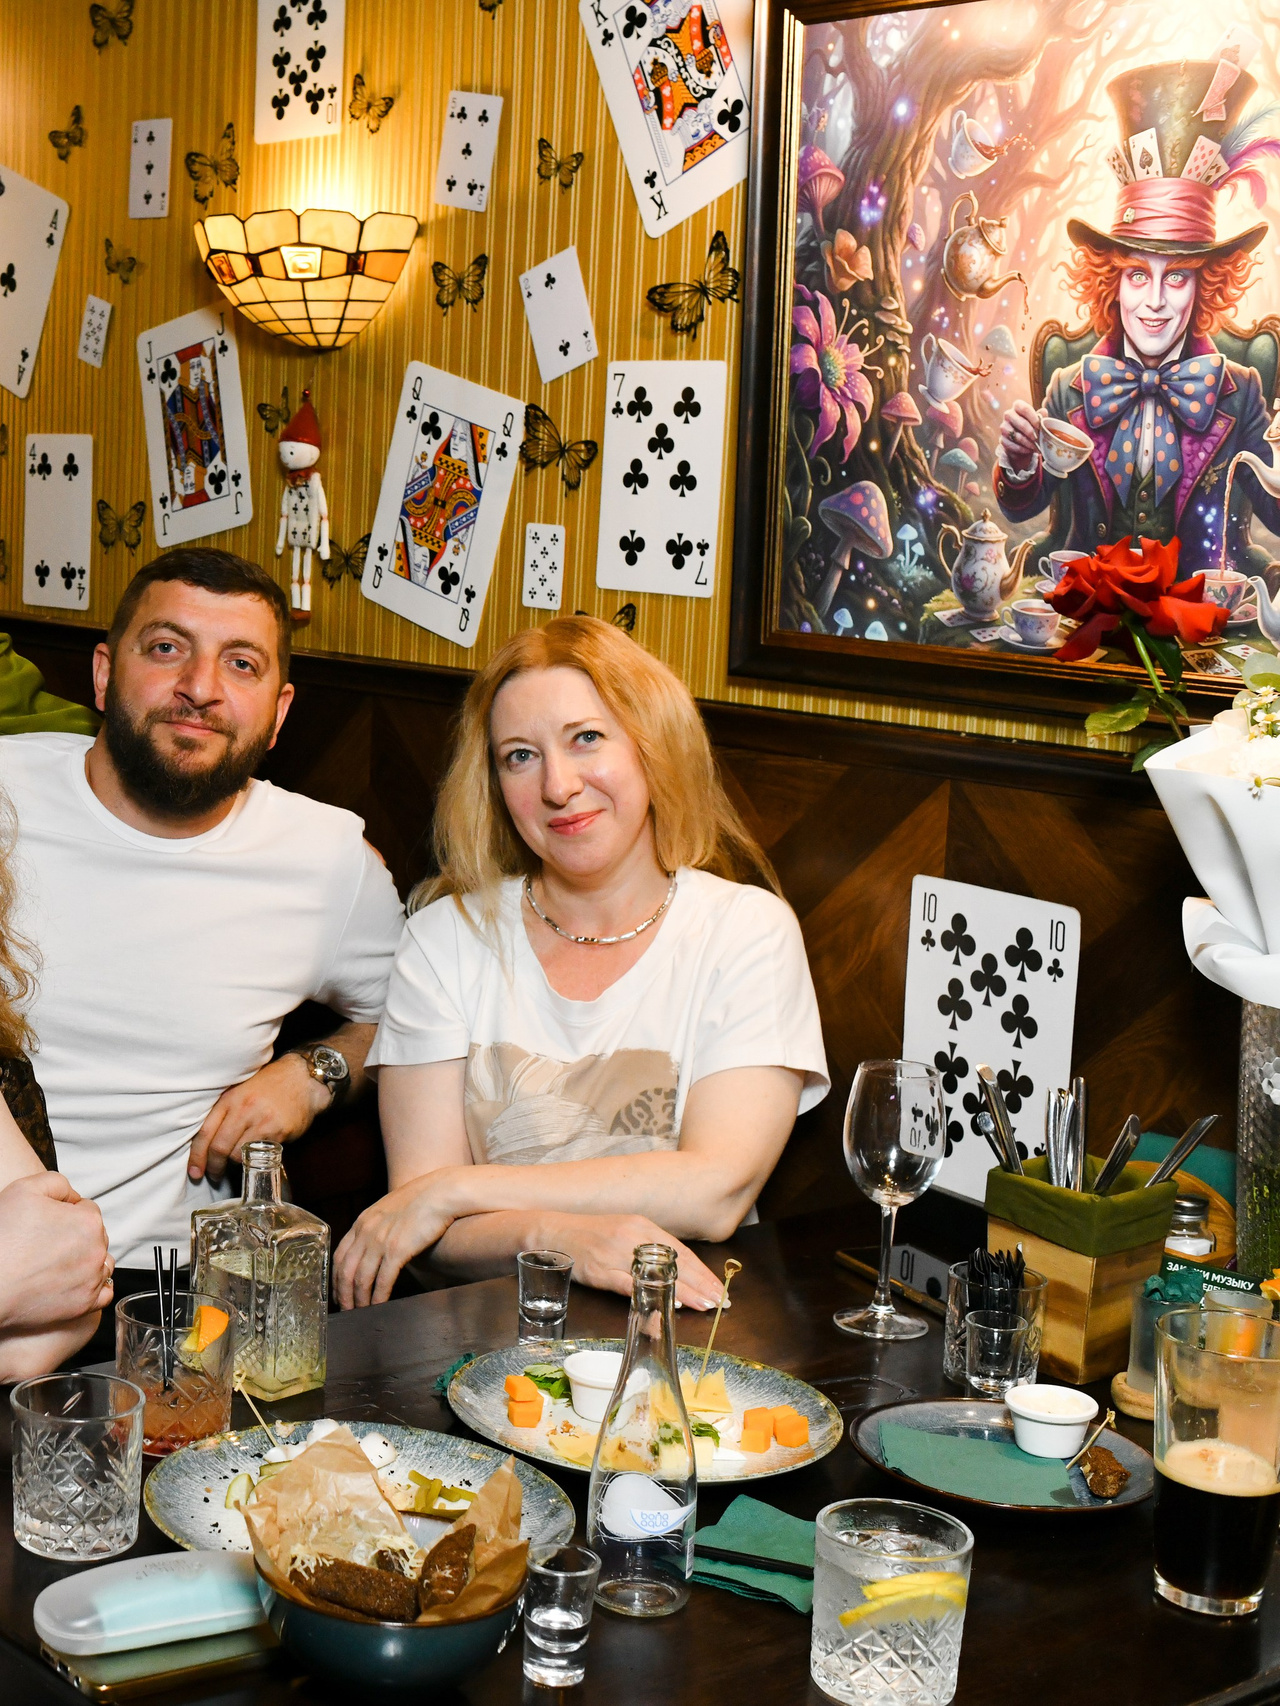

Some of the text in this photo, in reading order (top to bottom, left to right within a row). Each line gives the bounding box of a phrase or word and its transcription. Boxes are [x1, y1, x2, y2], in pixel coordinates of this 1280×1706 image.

[590, 0, 609, 28] K
[650, 190, 669, 221] K
[49, 208, 59, 231] A
[216, 311, 225, 336] J
[145, 340, 153, 364] J
[16, 364, 26, 386] A
[613, 373, 626, 397] 7
[412, 376, 423, 401] Q
[502, 412, 514, 438] Q
[29, 442, 37, 460] 4
[234, 491, 243, 515] J
[162, 513, 171, 536] J
[372, 564, 383, 589] Q
[694, 560, 708, 586] 7
[77, 583, 86, 601] 4
[458, 606, 470, 632] Q
[922, 892, 938, 923] 10
[1049, 919, 1066, 952] 10
[1211, 1272, 1255, 1291] МУЗЫКУ
